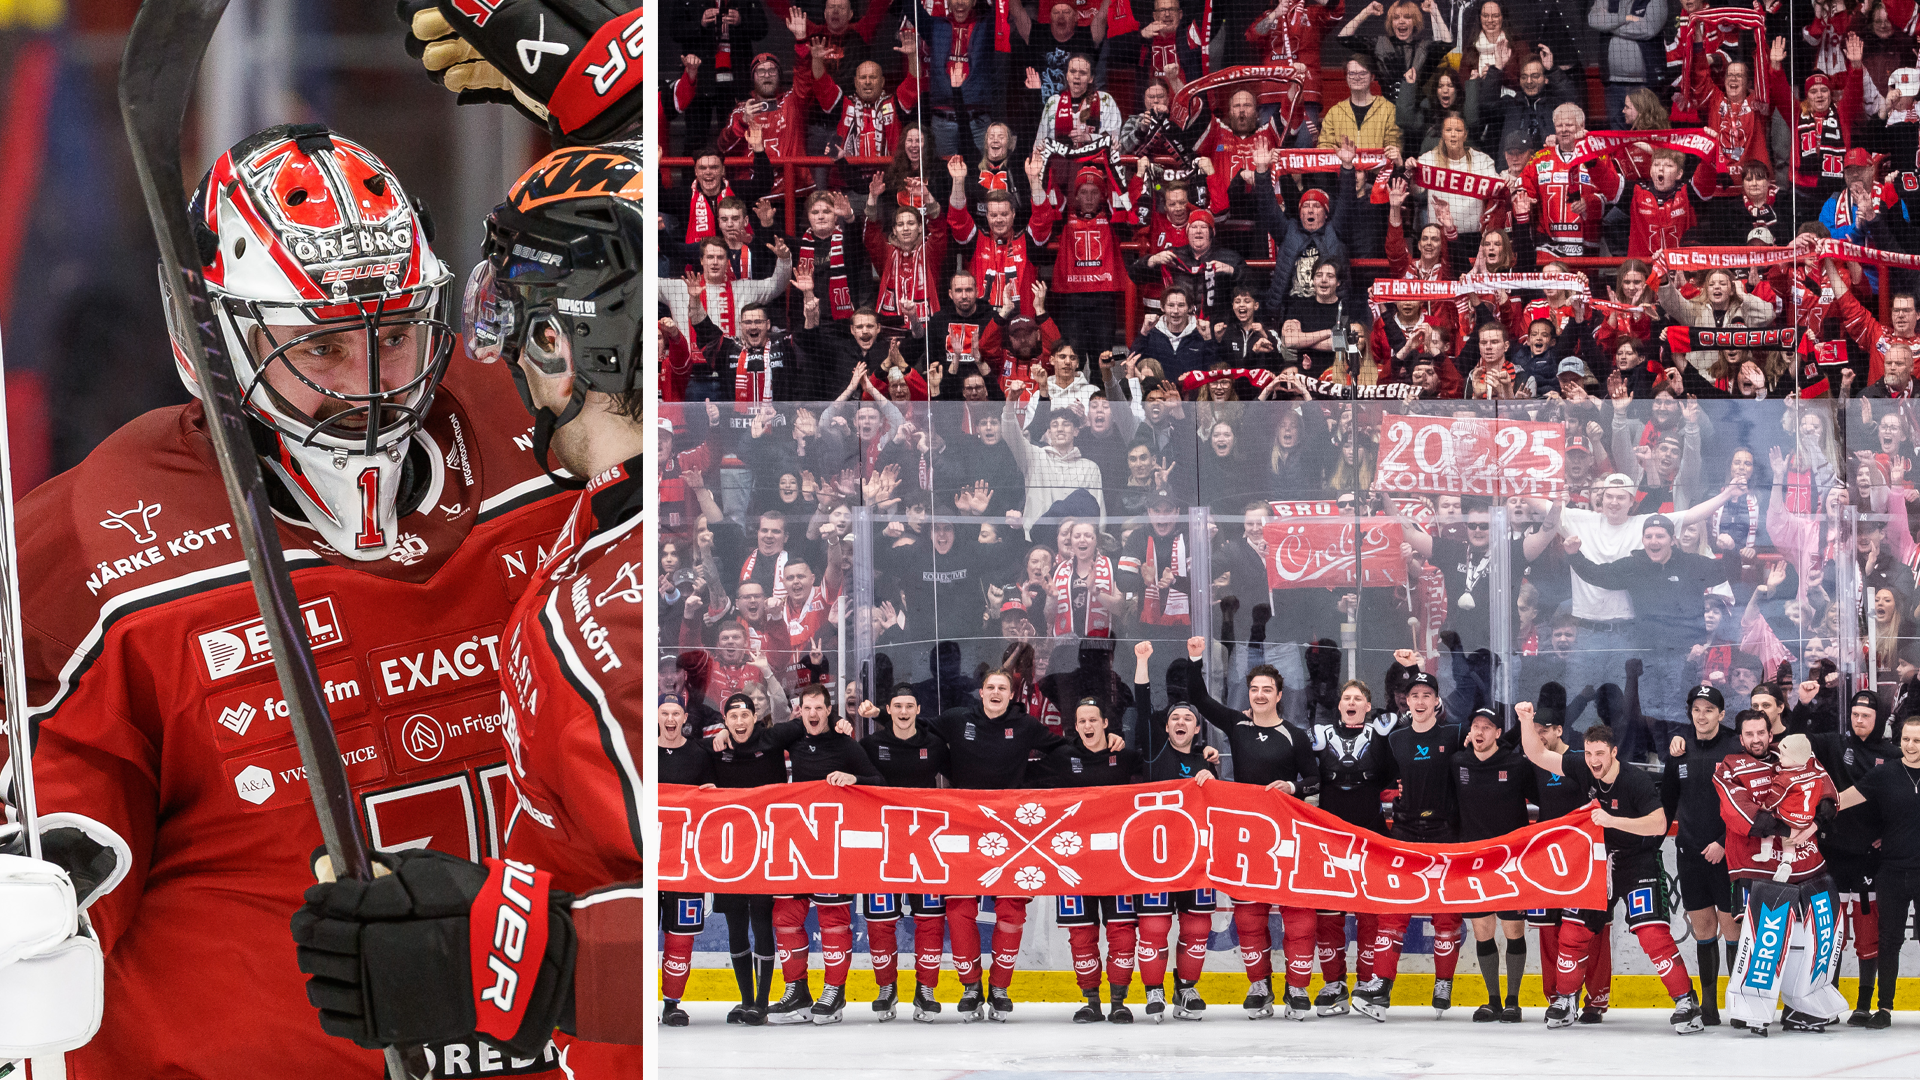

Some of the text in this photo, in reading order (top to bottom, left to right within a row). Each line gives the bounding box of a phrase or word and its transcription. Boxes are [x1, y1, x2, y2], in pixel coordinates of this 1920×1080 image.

[1422, 165, 1506, 197] ÖREBRO
[512, 243, 564, 267] BAUER
[1668, 252, 1689, 265] DET
[1708, 253, 1720, 266] VI
[1721, 253, 1748, 267] SOM
[320, 262, 402, 285] BAUER
[1410, 282, 1420, 295] VI
[1423, 282, 1449, 295] SOM
[1699, 327, 1795, 348] ÖREBRO
[448, 412, 475, 487] BYGGPRODUKTION
[1380, 421, 1564, 478] 20 25
[1374, 469, 1565, 496] KOLLEKTIVET
[355, 466, 386, 550] 1
[86, 522, 233, 596] NÄRKE KÖTT
[571, 574, 622, 673] NÄRKE KÖTT
[380, 635, 501, 696] EXACT
[446, 721, 462, 738] In
[341, 745, 378, 767] VICE
[240, 777, 271, 793] A&A
[880, 805, 949, 883] K
[1119, 790, 1594, 904] ÖREBRO
[480, 859, 536, 1013] UER
[1375, 935, 1390, 945] OAB
[1815, 897, 1829, 974] HEROK
[1831, 930, 1843, 968] BAUER
[872, 954, 889, 963] OAB
[1318, 947, 1333, 957] OAB
[1736, 936, 1750, 976] BAUER
[1751, 916, 1782, 985] HEROK
[1655, 959, 1670, 972] OAB
